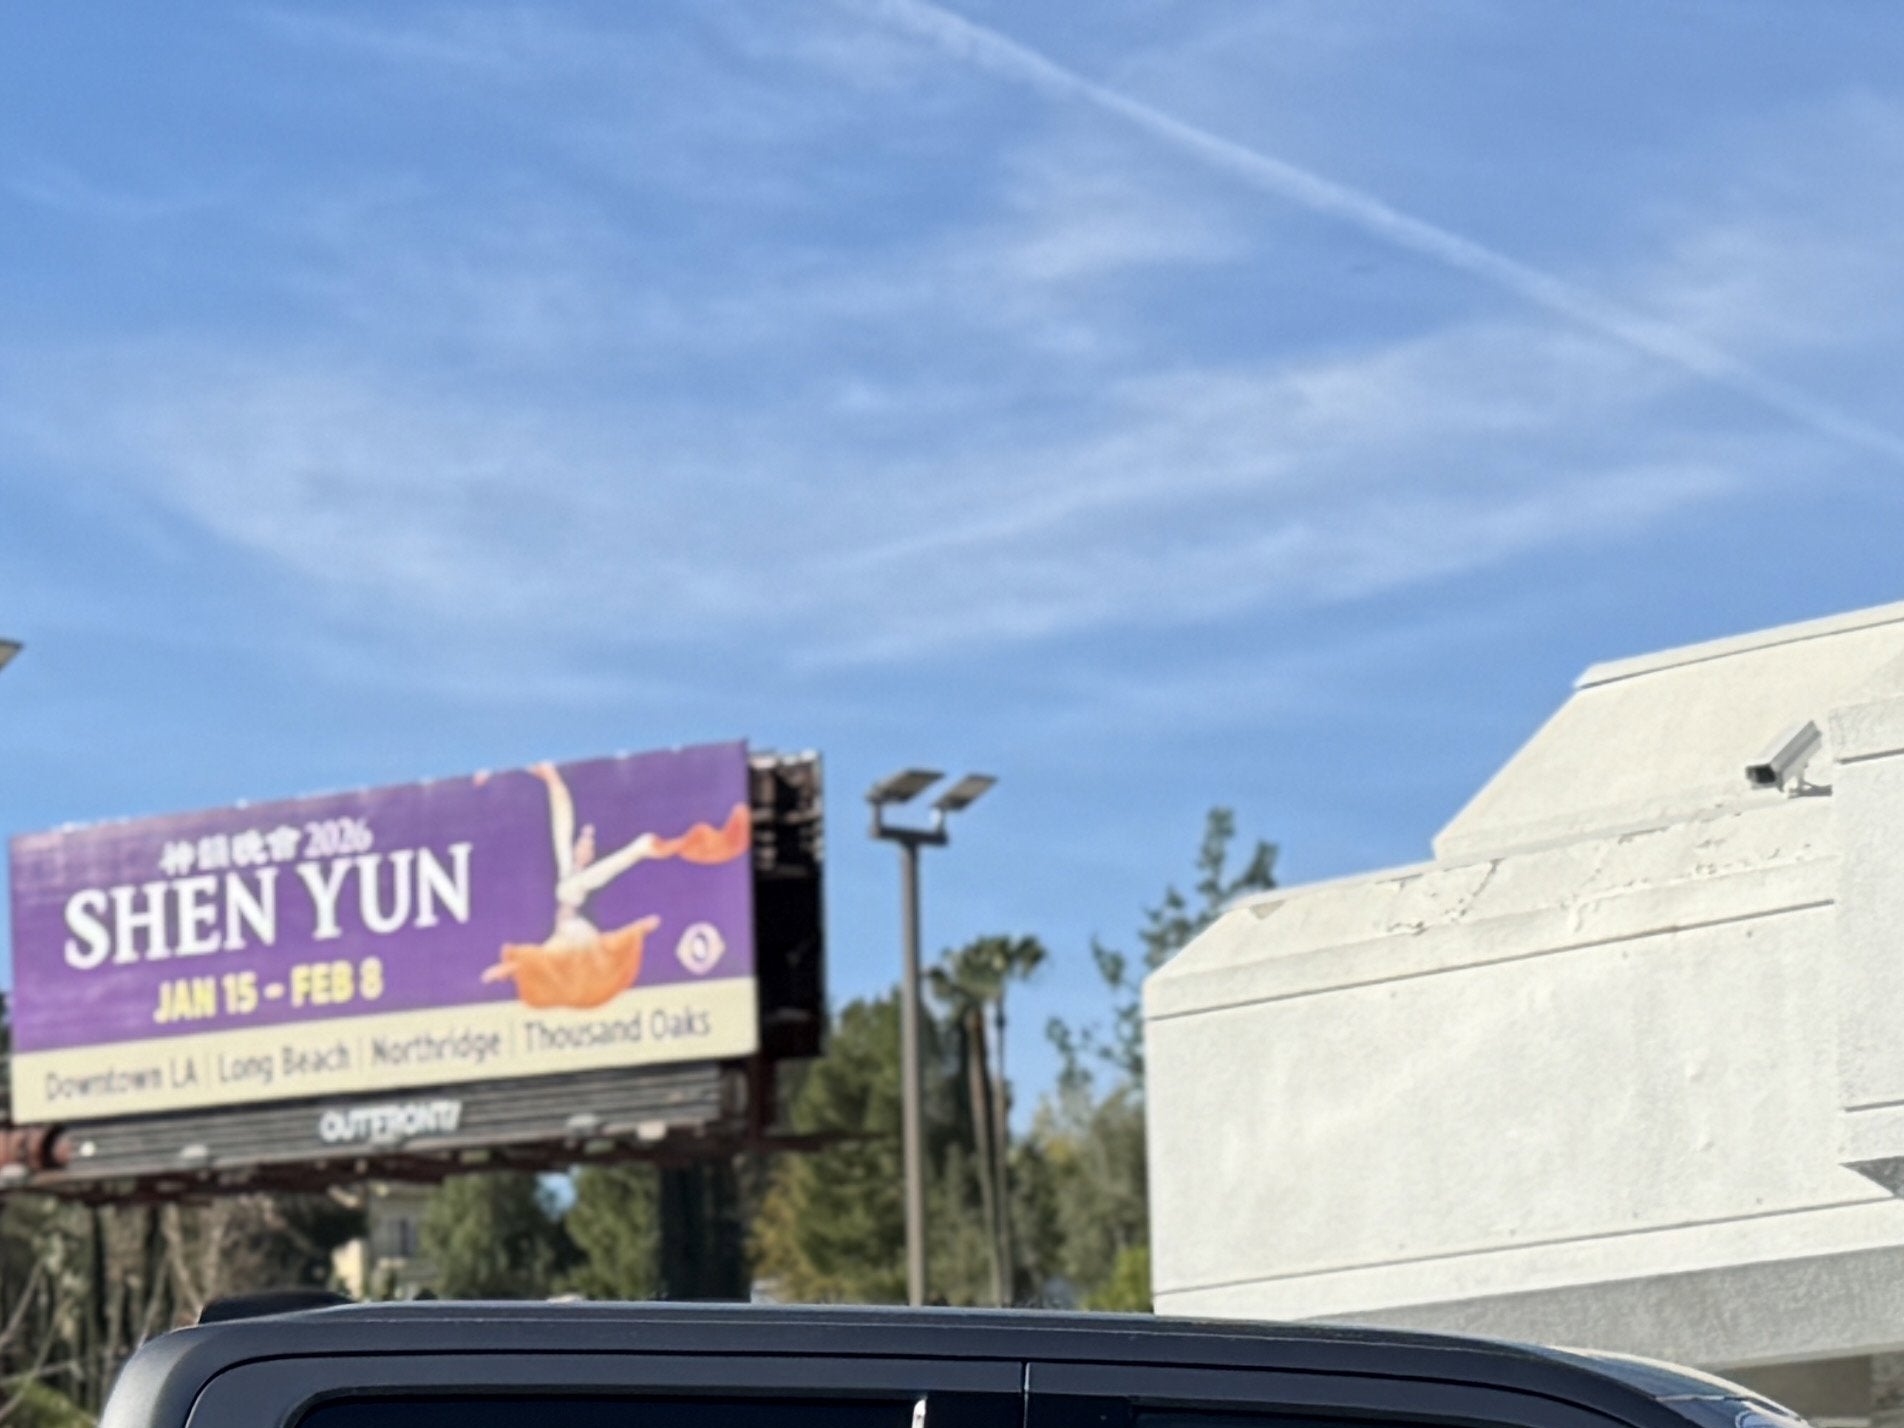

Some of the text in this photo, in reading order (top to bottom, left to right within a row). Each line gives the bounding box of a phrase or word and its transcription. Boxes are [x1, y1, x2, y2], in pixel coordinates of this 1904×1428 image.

[303, 816, 374, 860] 2026
[63, 841, 473, 970] SHEN YUN
[153, 976, 217, 1024] JAN
[222, 970, 258, 1015] 15
[290, 960, 355, 1009] FEB
[359, 955, 384, 1001] 8
[46, 1005, 712, 1101] Downtown LA Long Beach Northridge Thousand Oaks
